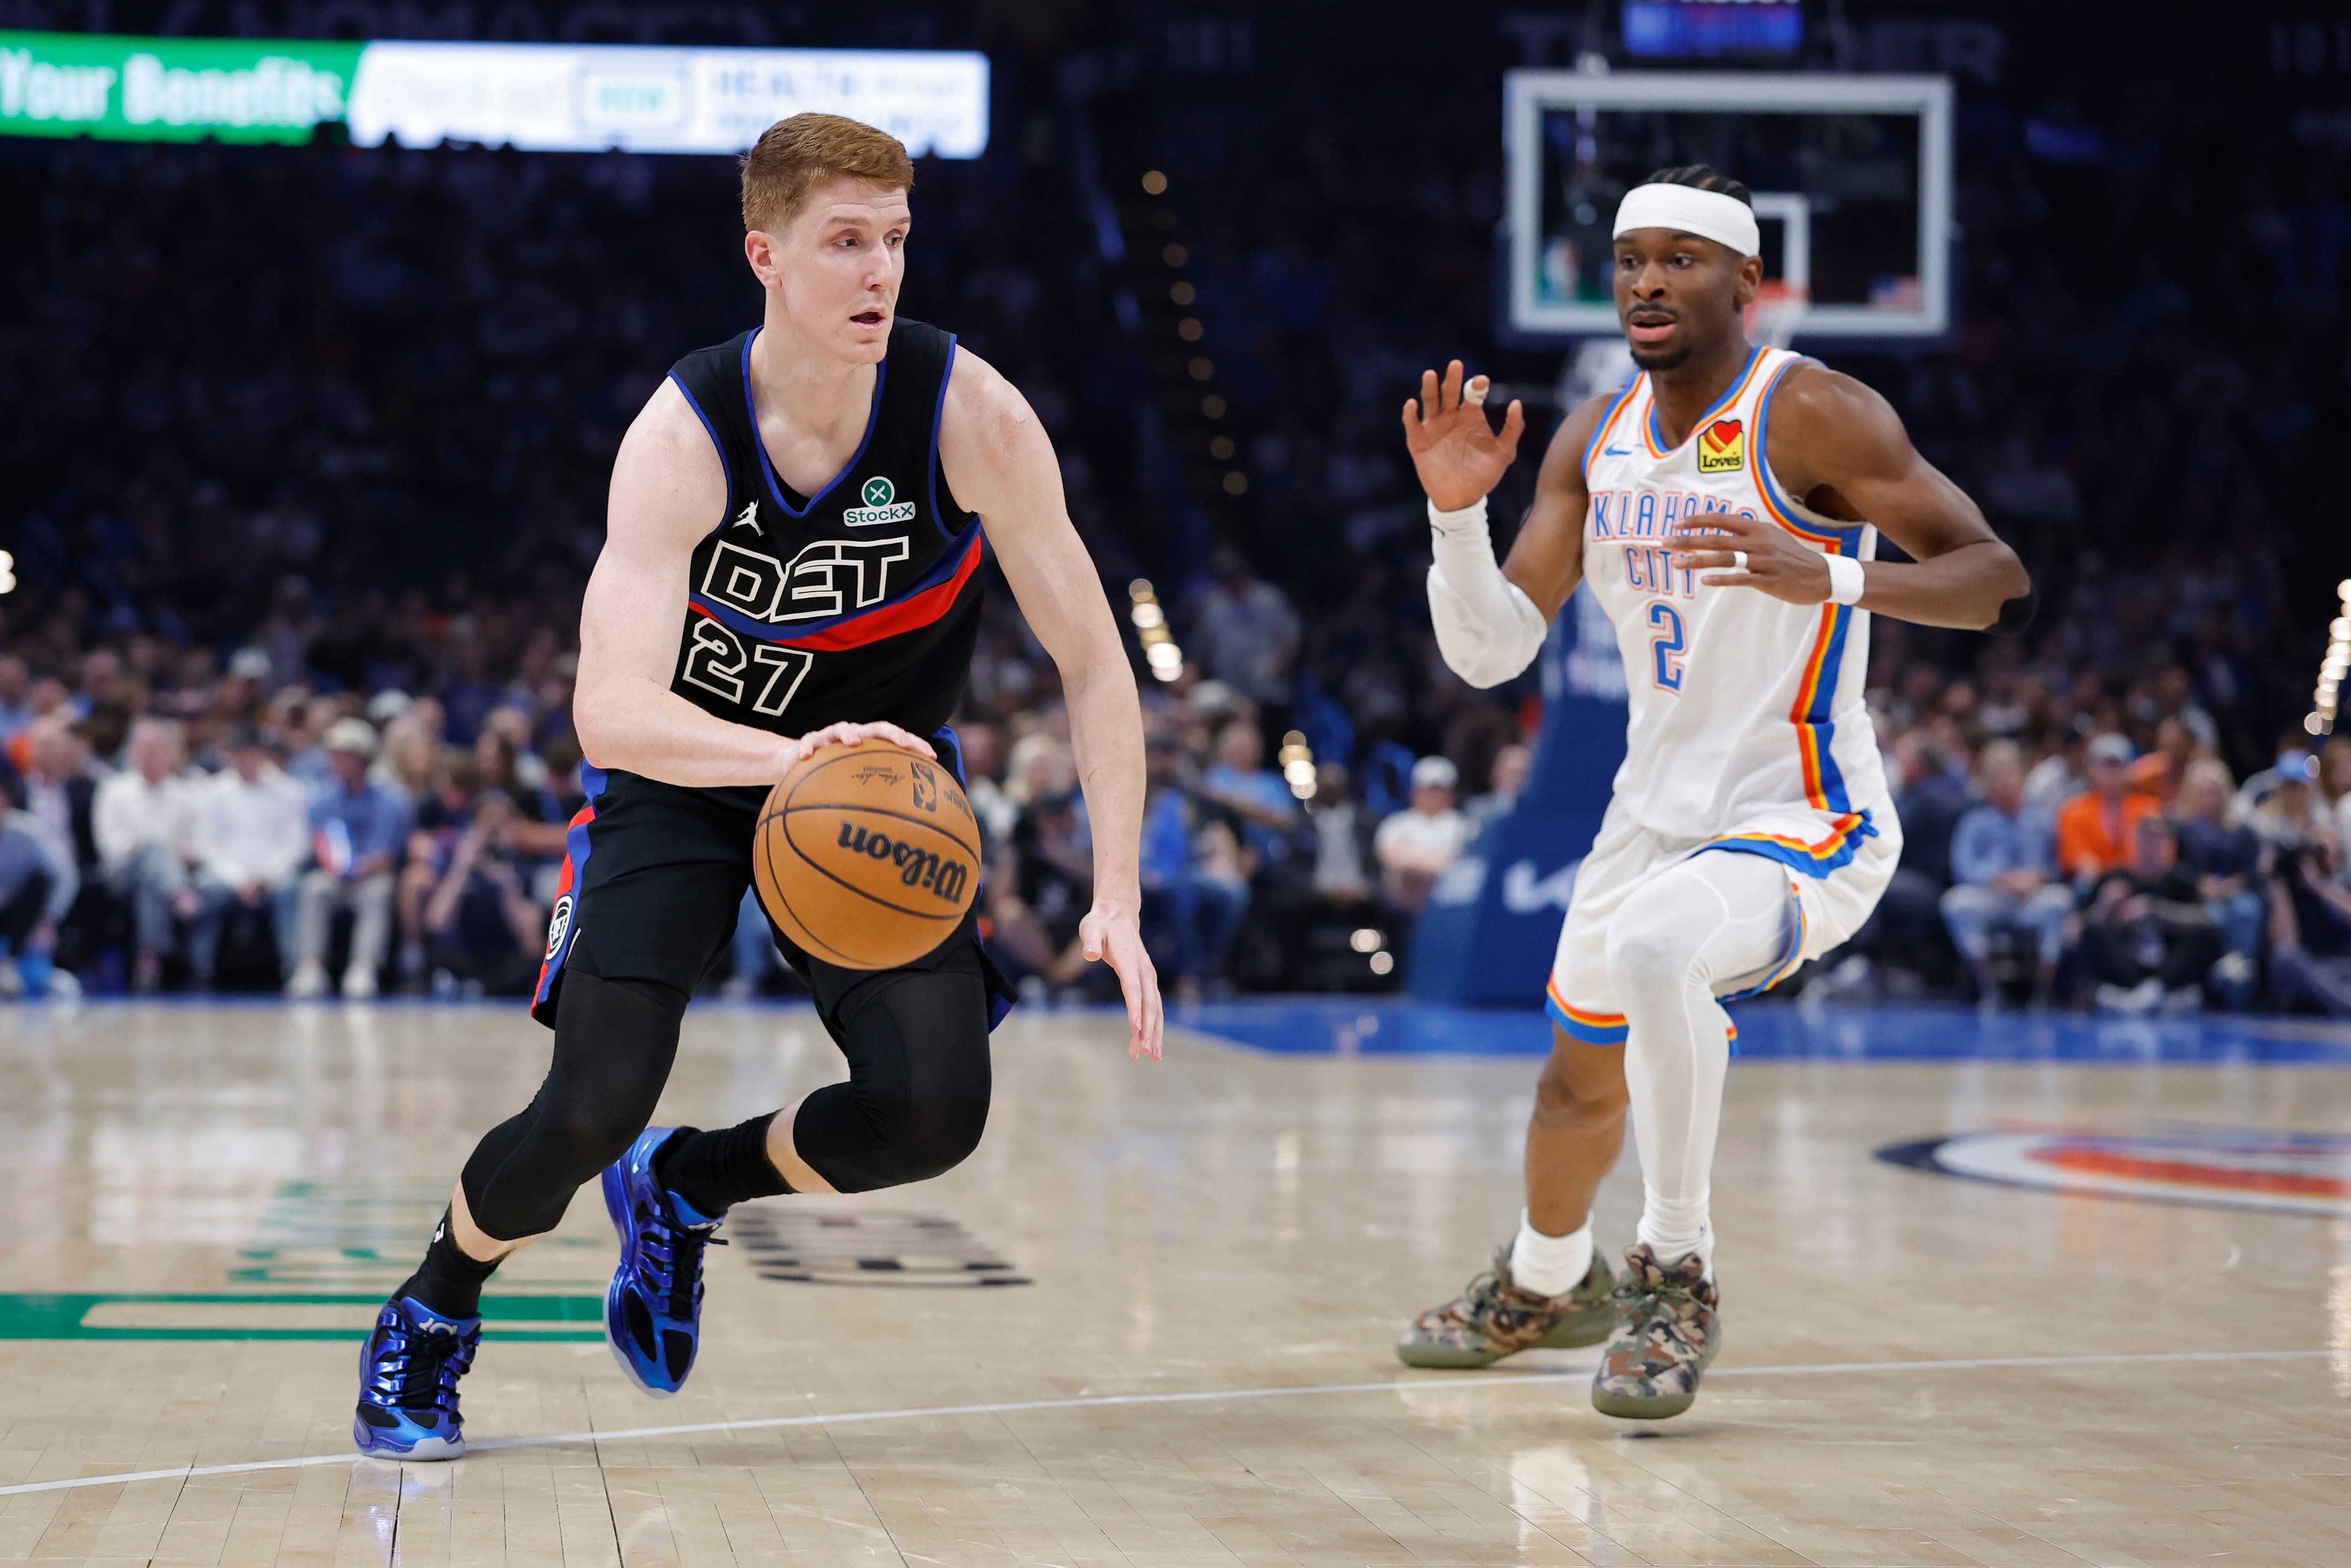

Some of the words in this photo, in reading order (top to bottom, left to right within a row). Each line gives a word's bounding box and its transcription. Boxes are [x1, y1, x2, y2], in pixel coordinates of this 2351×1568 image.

[0, 47, 117, 121] Your
[124, 53, 344, 127] Benefits
[846, 504, 913, 523] StockX
[1588, 490, 1759, 542] KLAHOM
[701, 536, 910, 623] DET
[1622, 544, 1696, 600] CITY
[683, 617, 814, 716] 27
[1646, 599, 1688, 697] 2
[836, 819, 967, 904] Wilson
